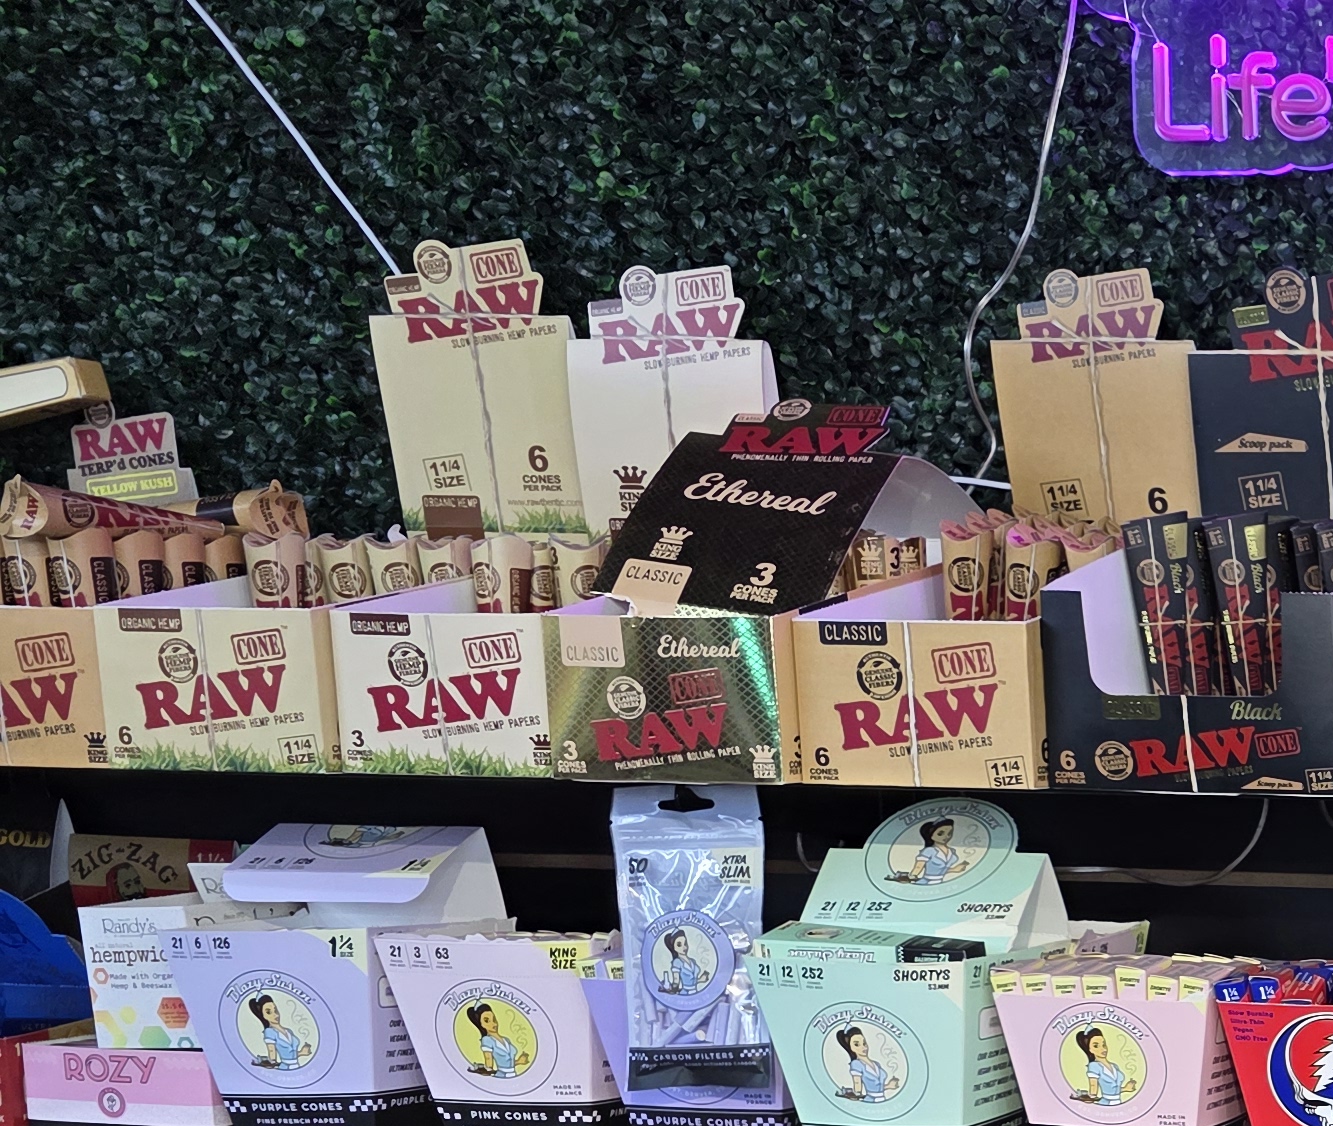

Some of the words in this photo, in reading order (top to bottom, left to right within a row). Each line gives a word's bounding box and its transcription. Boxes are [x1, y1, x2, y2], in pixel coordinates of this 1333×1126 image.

[75, 418, 166, 462] RAW
[719, 426, 886, 455] RAW
[1238, 438, 1264, 451] Scoop
[1266, 439, 1293, 450] pack
[78, 458, 126, 477] TERP'd
[129, 451, 175, 470] CONES
[91, 482, 138, 497] YELLOW
[140, 477, 174, 490] KUSH
[684, 473, 837, 516] Ethereal
[158, 618, 180, 629] HEMP
[824, 625, 883, 642] CLASSIC
[468, 639, 515, 664] CONE
[657, 635, 741, 659] Ethereal
[135, 663, 286, 730] RAW
[367, 668, 521, 732] RAW
[835, 683, 999, 751] RAW
[1231, 701, 1282, 721] Black
[422, 728, 442, 739] SLOW
[446, 723, 480, 736] BURNING
[483, 720, 504, 731] HEMP
[509, 715, 541, 729] PAPERS
[72, 844, 178, 884] ZIG-ZAG
[722, 856, 747, 867] XTRA
[719, 866, 751, 880] SLIM
[102, 918, 158, 934] Randy's
[801, 967, 824, 980] 252
[893, 969, 951, 982] SHORTYS
[653, 1054, 693, 1062] CARBON
[695, 1052, 734, 1061] FILTERS
[65, 1054, 155, 1084] ROZY
[252, 1102, 300, 1112] PURPLE
[302, 1102, 343, 1112] CONES
[471, 1110, 501, 1121] PINK
[506, 1110, 548, 1121] CONES
